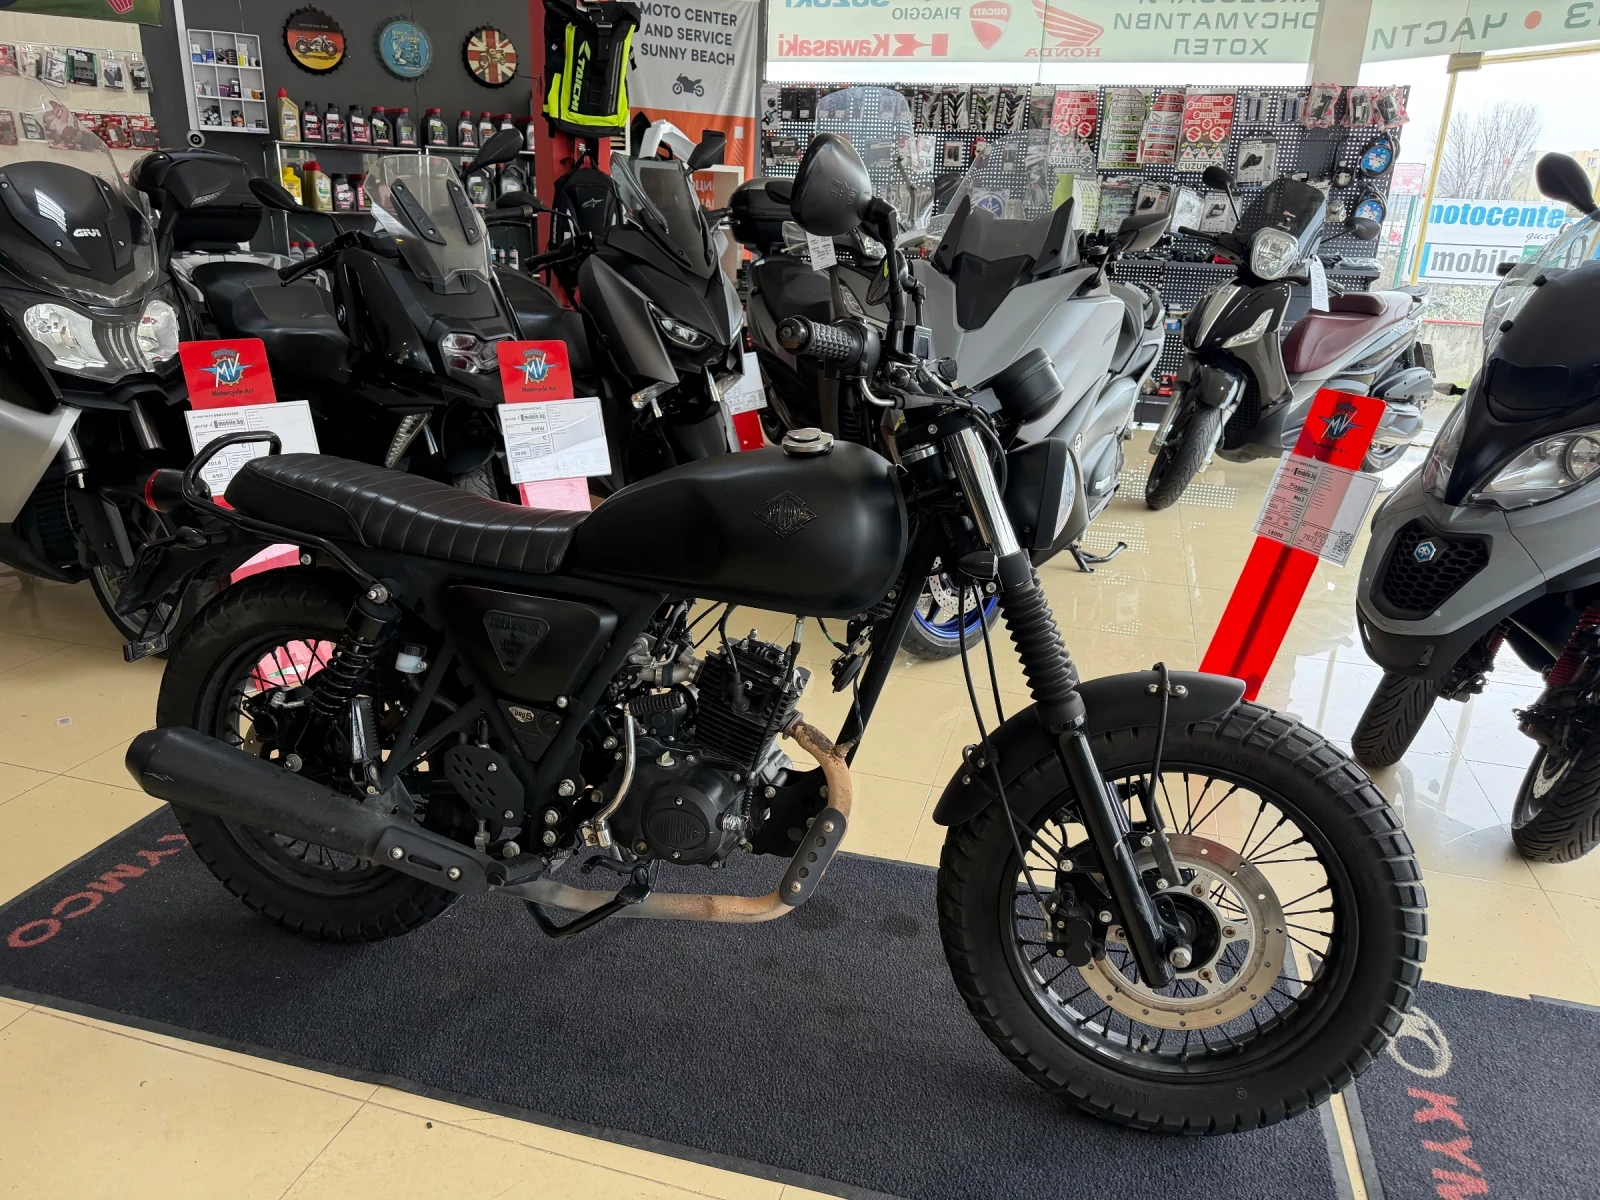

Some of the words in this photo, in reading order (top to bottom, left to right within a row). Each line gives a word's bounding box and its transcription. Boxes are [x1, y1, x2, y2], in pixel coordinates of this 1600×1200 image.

[639, 3, 681, 18] MOTO
[684, 7, 738, 27] CENTER
[644, 23, 673, 39] AND
[677, 26, 733, 46] SERVICE
[640, 42, 687, 61] SUNNY
[691, 47, 736, 66] BEACH
[571, 57, 586, 112] TAICHI
[1428, 203, 1572, 228] motocente
[73, 228, 102, 237] GIVI
[216, 352, 240, 388] MV
[524, 352, 547, 385] MV
[211, 389, 243, 397] Motorcycle
[217, 419, 244, 427] mobile.bg
[1320, 410, 1359, 439] MV
[1289, 482, 1309, 492] Piaggio
[1293, 494, 1305, 502] Mp3
[1267, 528, 1284, 539] 18000
[1313, 530, 1329, 540] 4000
